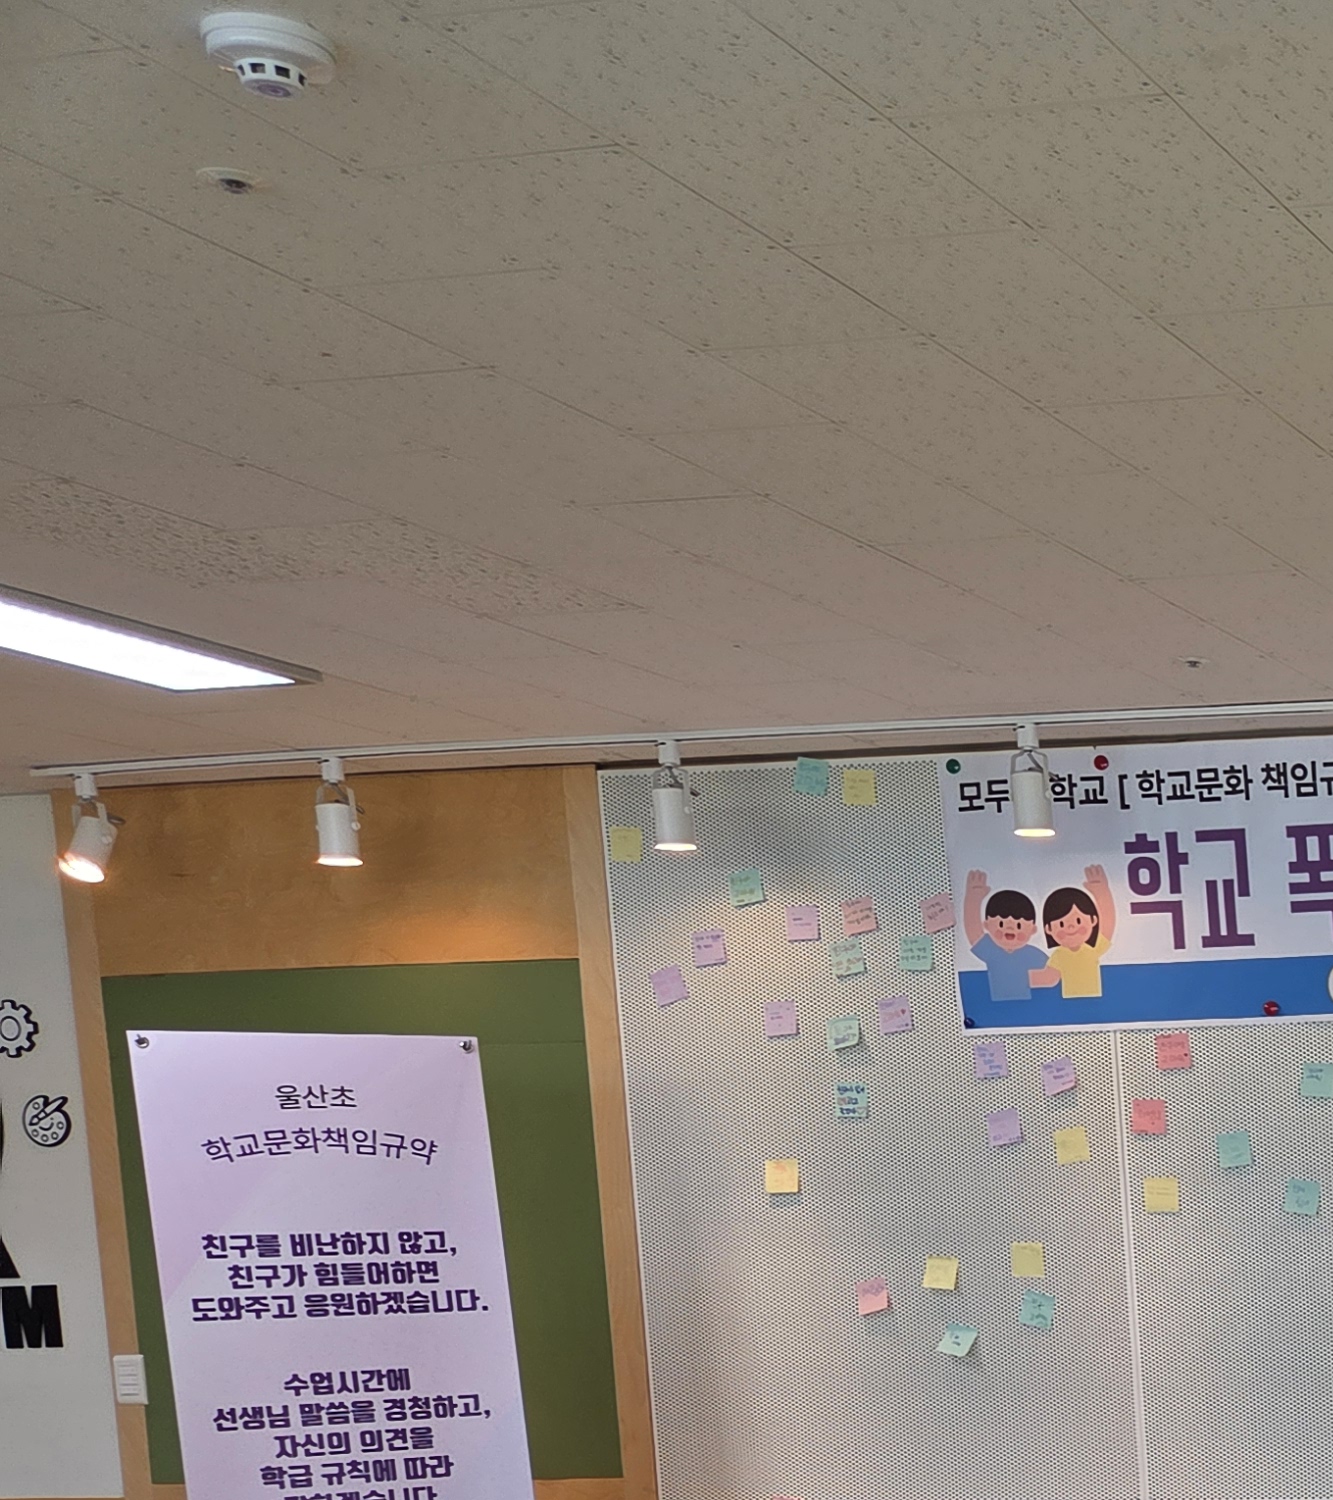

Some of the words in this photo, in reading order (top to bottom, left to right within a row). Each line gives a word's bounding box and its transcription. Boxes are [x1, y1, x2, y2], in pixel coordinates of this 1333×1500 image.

[958, 779, 1024, 814] 모두
[1049, 774, 1109, 810] 학교
[1135, 764, 1254, 806] 학교문화
[1123, 827, 1256, 950] 학교
[274, 1084, 358, 1110] 울산초
[200, 1126, 439, 1166] 학교문화책임규약
[201, 1233, 282, 1260] 친구를
[289, 1231, 391, 1257] 비난하지
[397, 1230, 457, 1257] 않고,
[227, 1263, 309, 1290] 친구가
[312, 1260, 440, 1287] 힘들어하면
[191, 1294, 298, 1322] 도와주고
[303, 1288, 489, 1318] 응원하겠습니다.
[283, 1367, 412, 1397] 수업시간에
[212, 1404, 292, 1432] 선생님
[298, 1399, 377, 1428] 말씀을
[382, 1393, 491, 1422] 경청하고,
[273, 1431, 352, 1459] 자신의
[359, 1426, 435, 1454] 의견을
[259, 1464, 314, 1490] 학급
[320, 1458, 398, 1486] 규칙에
[402, 1454, 455, 1481] 따라
